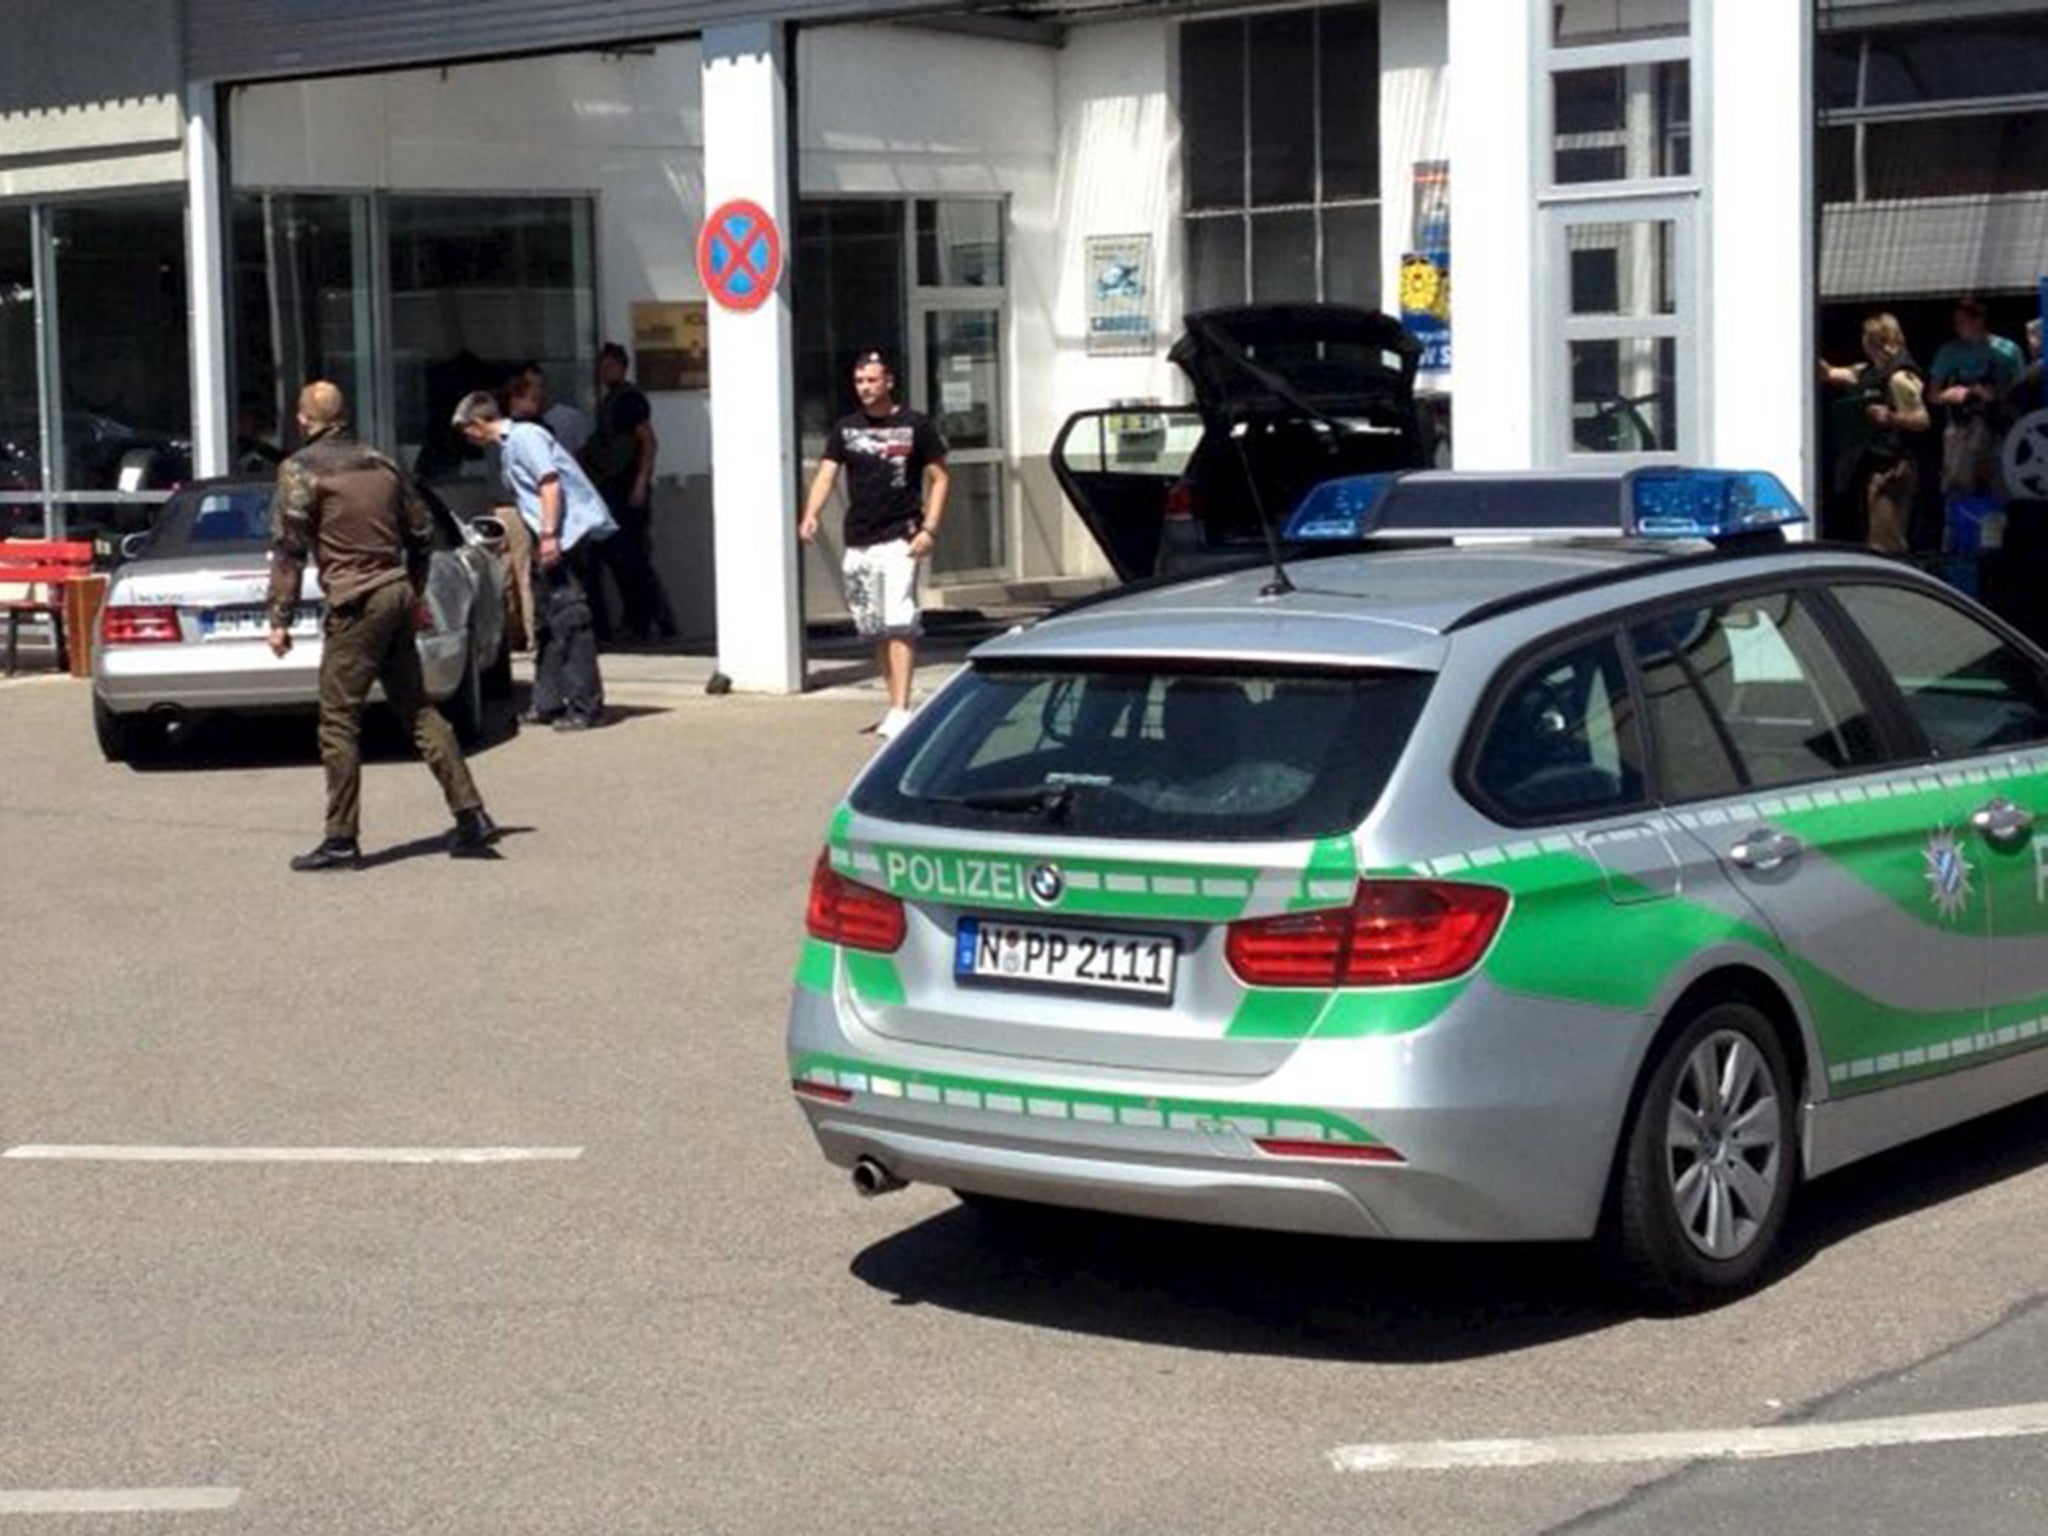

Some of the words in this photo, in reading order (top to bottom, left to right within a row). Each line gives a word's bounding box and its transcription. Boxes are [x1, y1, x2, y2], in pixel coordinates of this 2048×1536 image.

[886, 852, 1025, 900] POLIZEI
[979, 927, 1001, 970] N
[1024, 931, 1068, 974] PP
[1075, 936, 1165, 985] 2111
